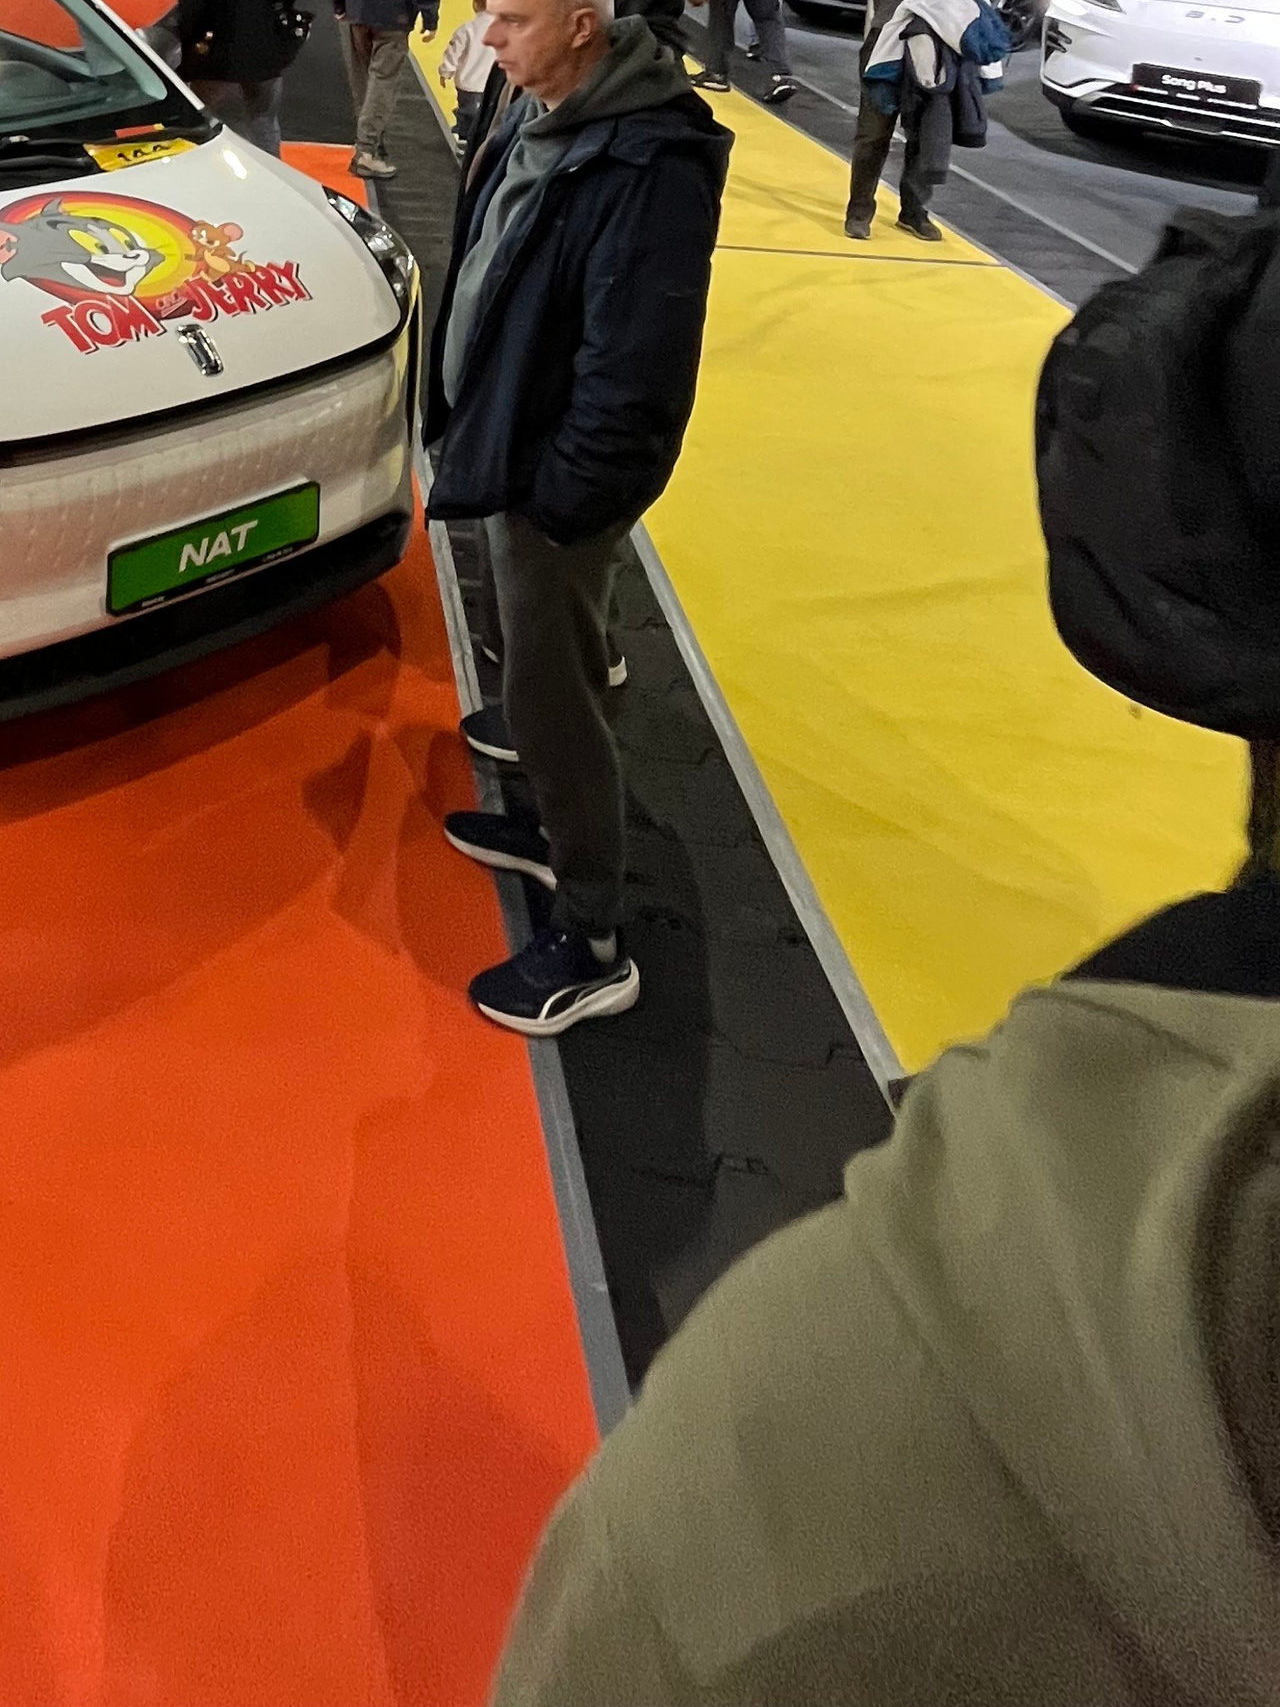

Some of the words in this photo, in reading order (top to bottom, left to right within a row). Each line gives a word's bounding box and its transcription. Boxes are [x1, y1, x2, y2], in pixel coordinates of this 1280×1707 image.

[1161, 74, 1197, 91] Song
[1197, 80, 1227, 94] Plus
[40, 294, 167, 355] TOM
[184, 259, 312, 323] JERRY
[179, 519, 258, 573] NAT
